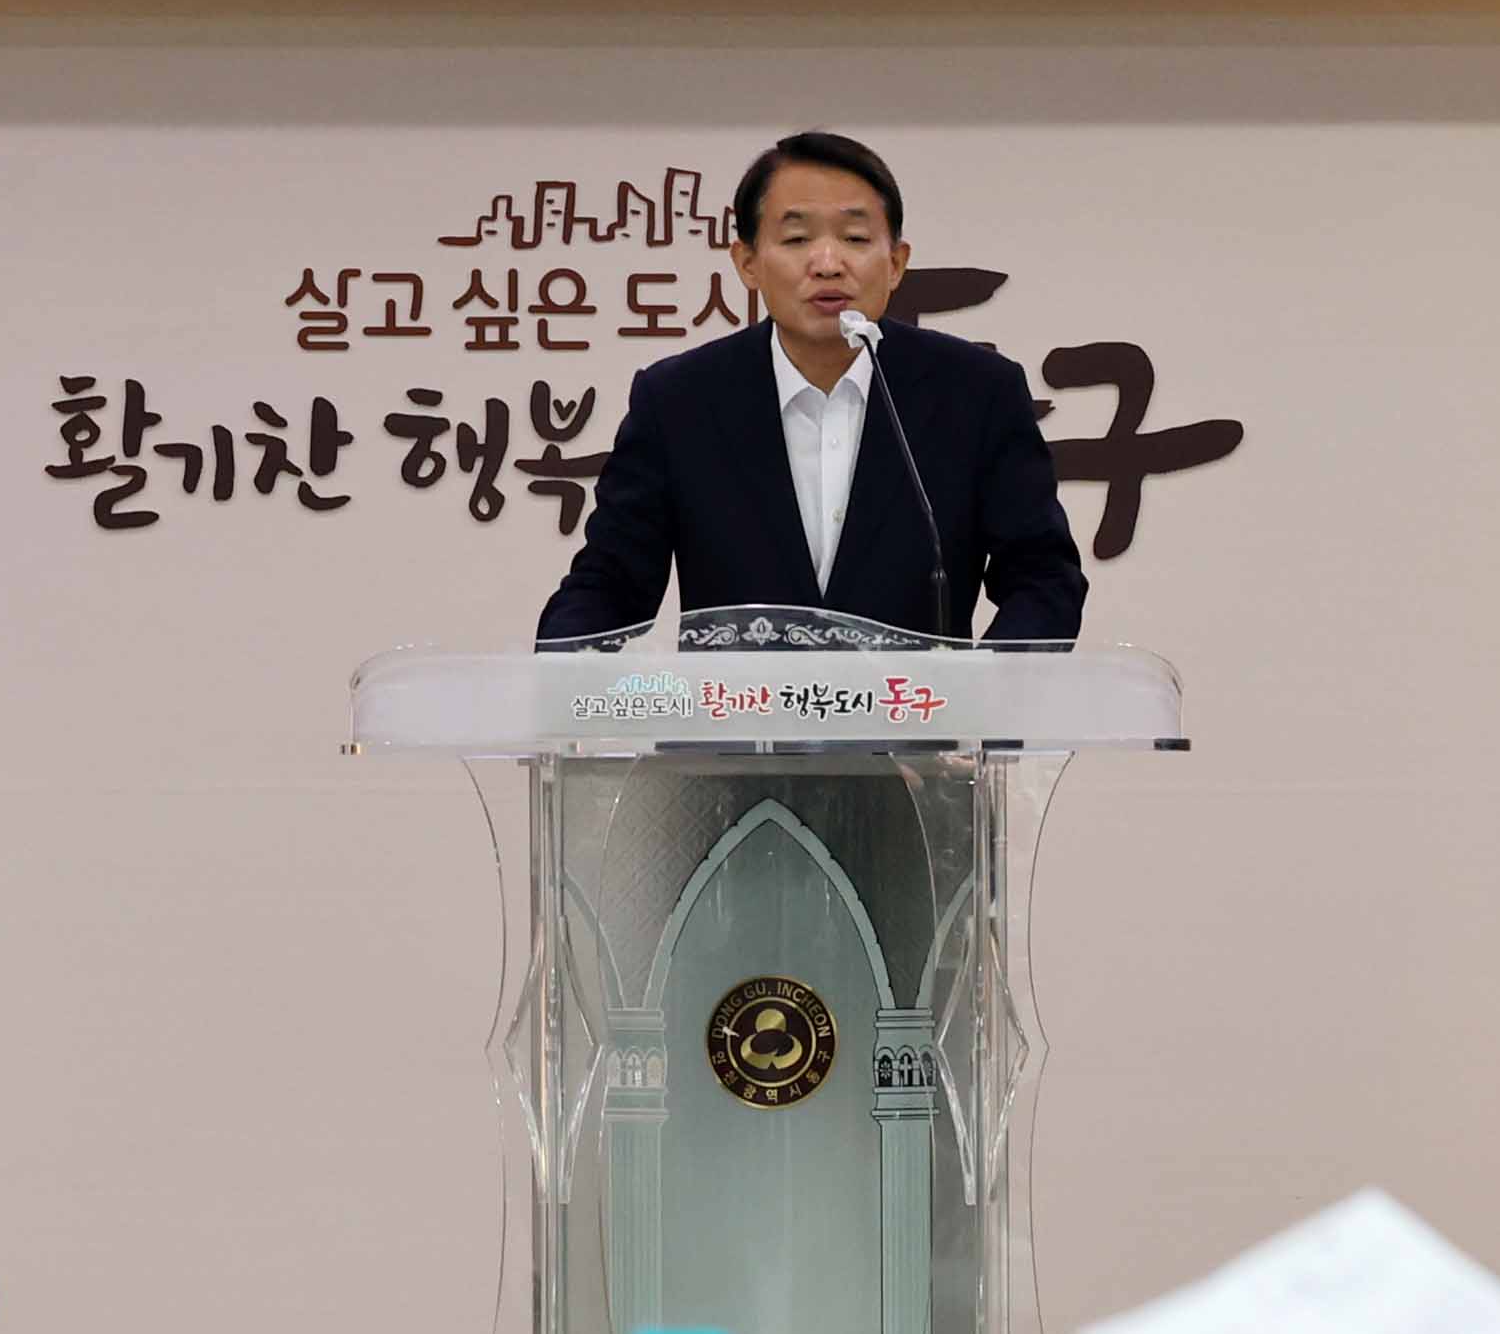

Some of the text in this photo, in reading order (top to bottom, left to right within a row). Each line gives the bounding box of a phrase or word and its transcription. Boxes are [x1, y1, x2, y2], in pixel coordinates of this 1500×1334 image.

[284, 266, 760, 352] 살고 싶은 도시
[43, 374, 356, 531] 활기찬
[382, 379, 612, 537] 행복
[571, 695, 694, 719] 살고 싶은 도시!
[699, 677, 947, 723] 활기찬 행복도시 동구
[711, 993, 743, 1040] DONG
[776, 981, 832, 1039] INCHEON
